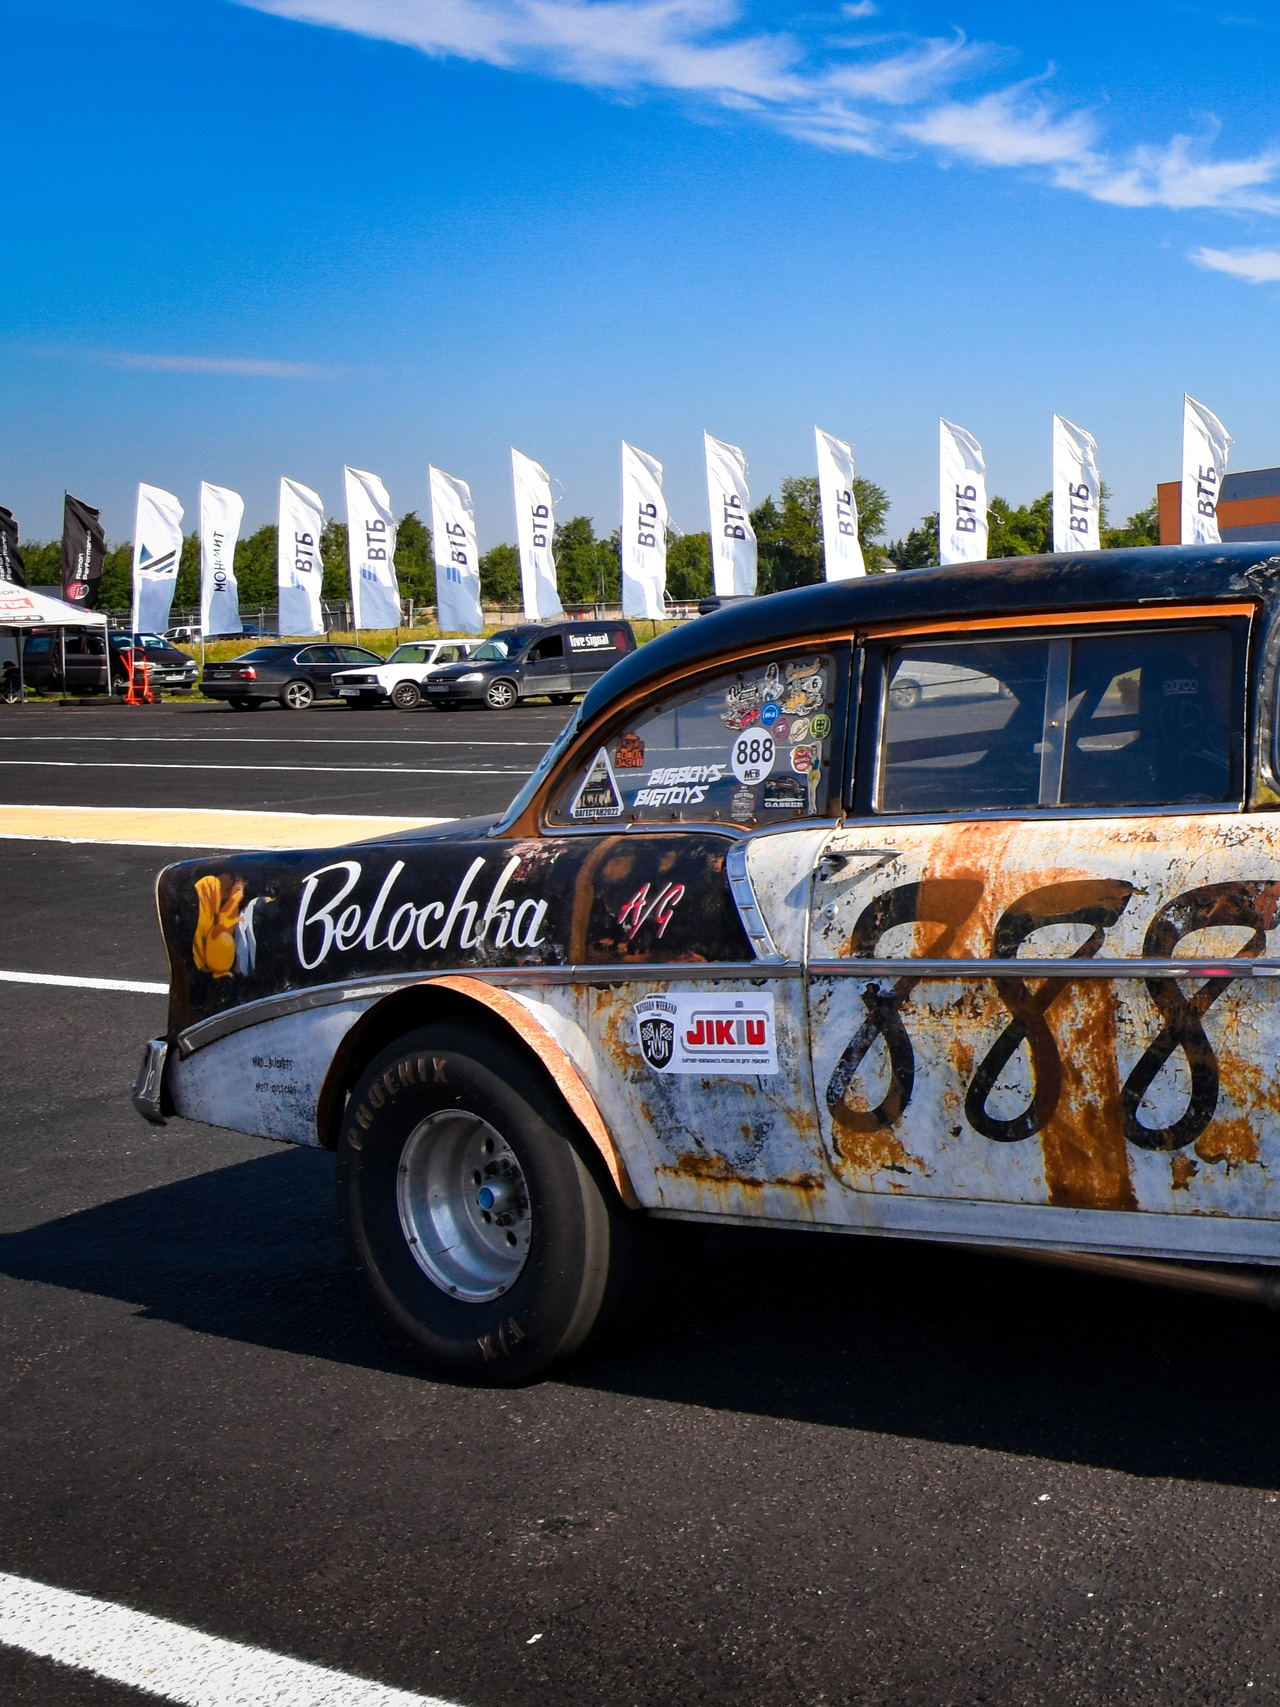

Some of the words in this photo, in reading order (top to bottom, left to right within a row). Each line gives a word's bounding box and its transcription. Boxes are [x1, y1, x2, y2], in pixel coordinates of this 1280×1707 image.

[836, 489, 855, 537] ВТБ
[955, 484, 977, 534] ВТБ
[1068, 482, 1090, 534] ВТБ
[1197, 464, 1217, 519] ВТБ
[531, 504, 549, 548] ВТБ
[637, 501, 657, 548] ВТБ
[723, 493, 746, 541] ВТБ
[295, 531, 314, 573] ВТБ
[365, 519, 387, 561] ВТБ
[446, 521, 468, 565] ВТБ
[569, 634, 585, 648] live
[585, 632, 609, 648] signal
[737, 738, 773, 765] 888
[633, 785, 710, 807] BIGTOYS
[647, 763, 727, 786] BIGBOYS
[296, 855, 548, 969] Belochka
